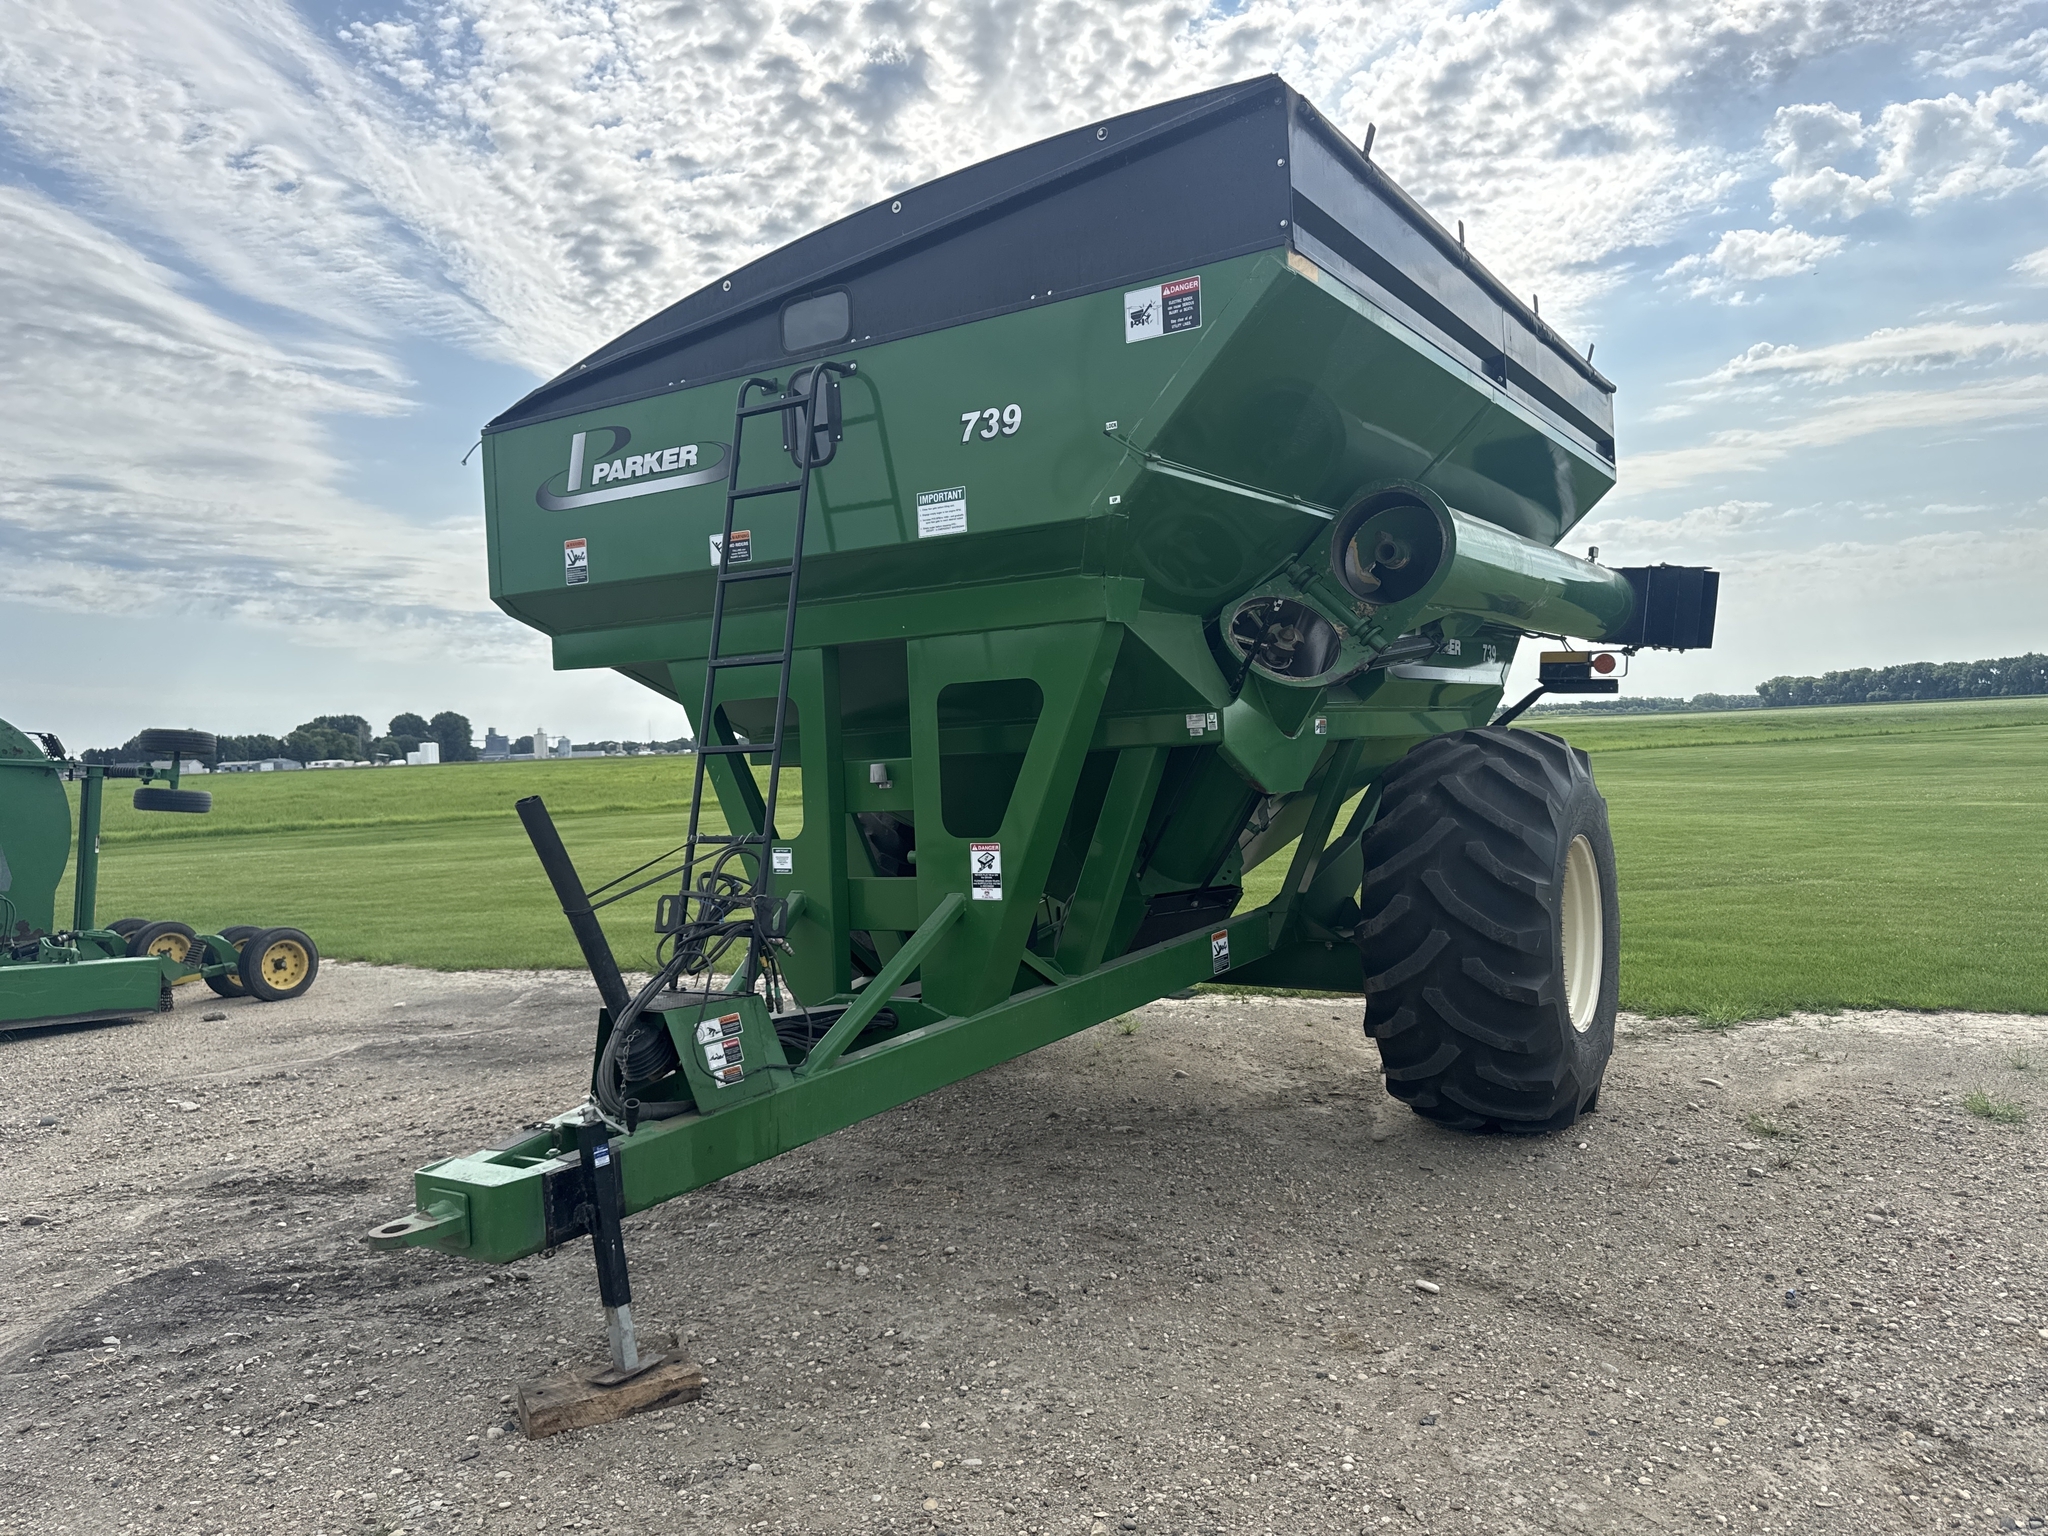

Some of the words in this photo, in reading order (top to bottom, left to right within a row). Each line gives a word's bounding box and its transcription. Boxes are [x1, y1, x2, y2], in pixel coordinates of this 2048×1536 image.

[1170, 280, 1198, 293] DANGER
[961, 403, 1022, 443] 739
[591, 444, 699, 486] PARKER
[919, 489, 963, 505] IMPORTANT
[1482, 644, 1497, 662] 739
